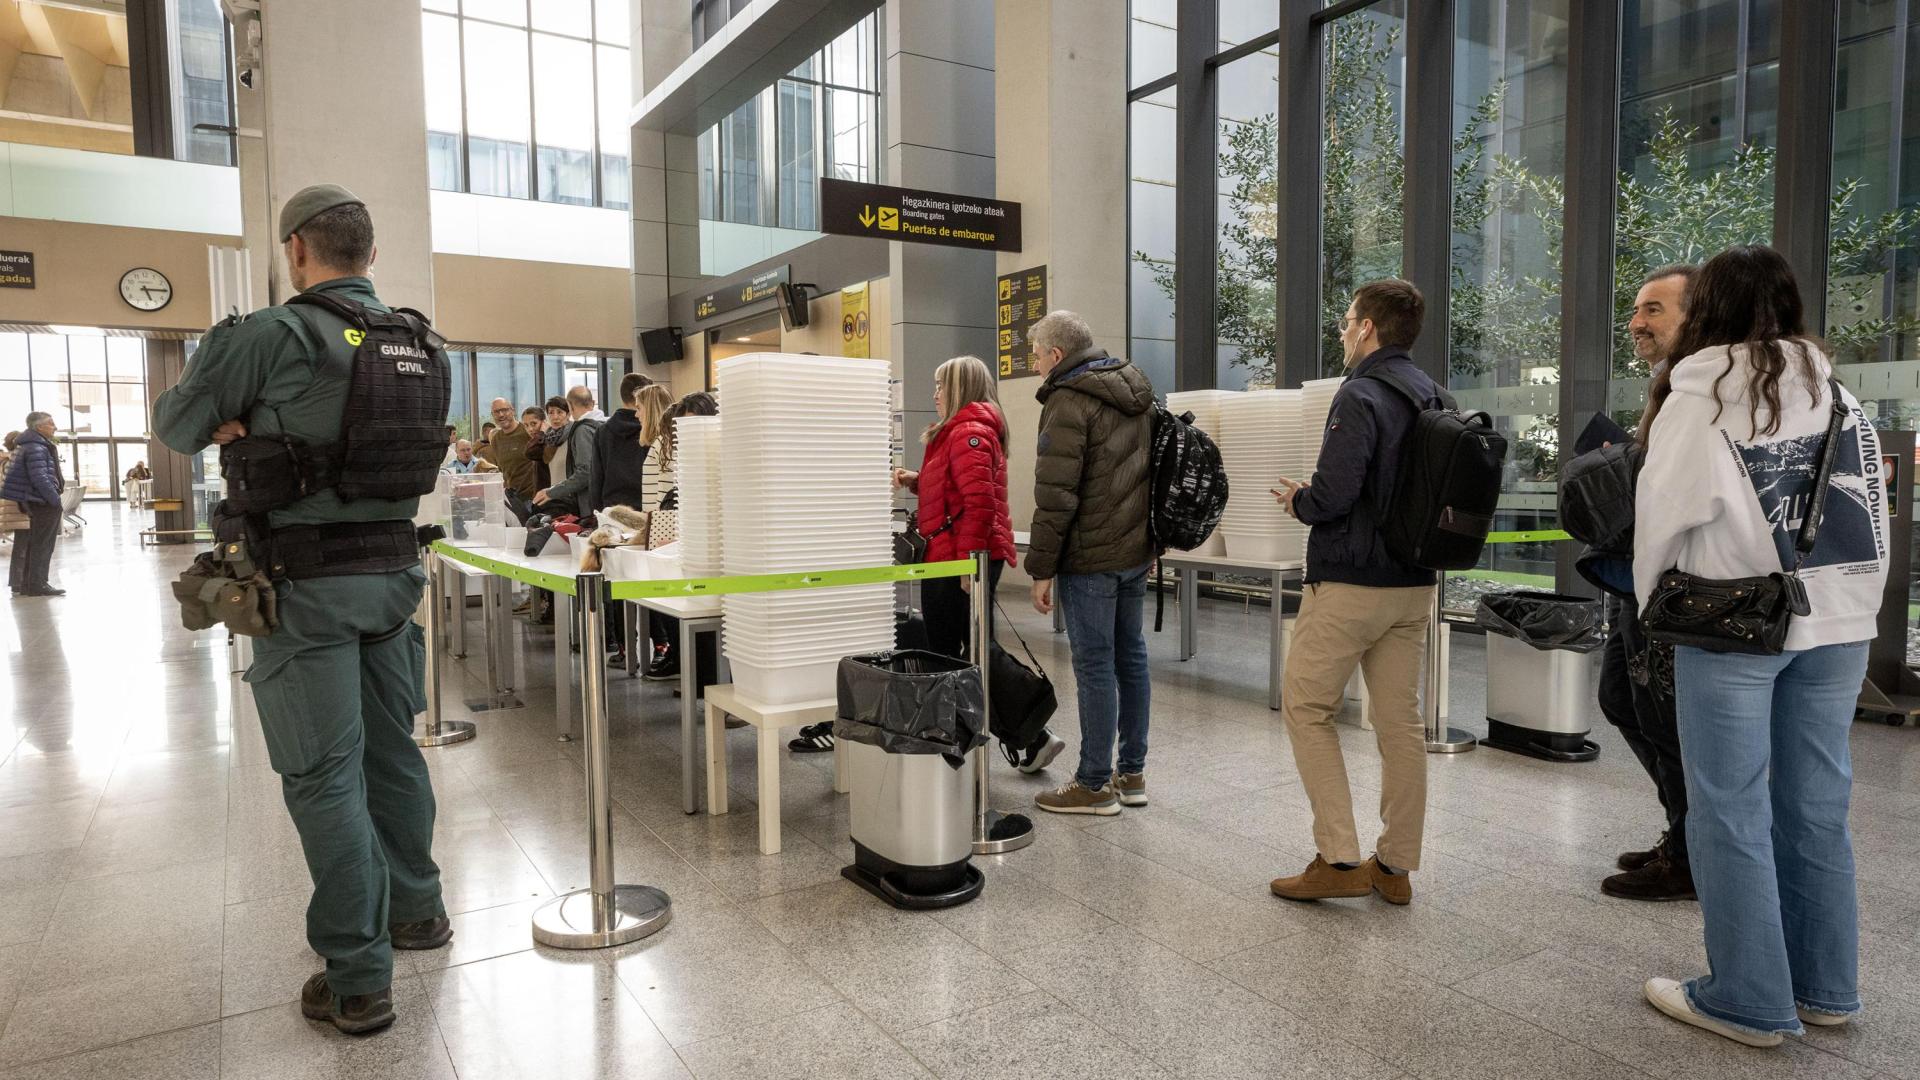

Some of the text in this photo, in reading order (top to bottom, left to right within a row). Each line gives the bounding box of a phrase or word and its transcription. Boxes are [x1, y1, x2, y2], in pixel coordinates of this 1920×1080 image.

[902, 195, 1005, 217] Hegazkinera igotzeko ateak
[902, 208, 945, 221] Boarding gates
[902, 222, 995, 242] Puertas de embarque
[381, 344, 429, 359] GUARDIA
[396, 361, 425, 374] CIVIL
[1730, 449, 1740, 462] THIS
[1736, 461, 1747, 478] ENJOY
[1850, 407, 1886, 560] DRIVING NOWHERE
